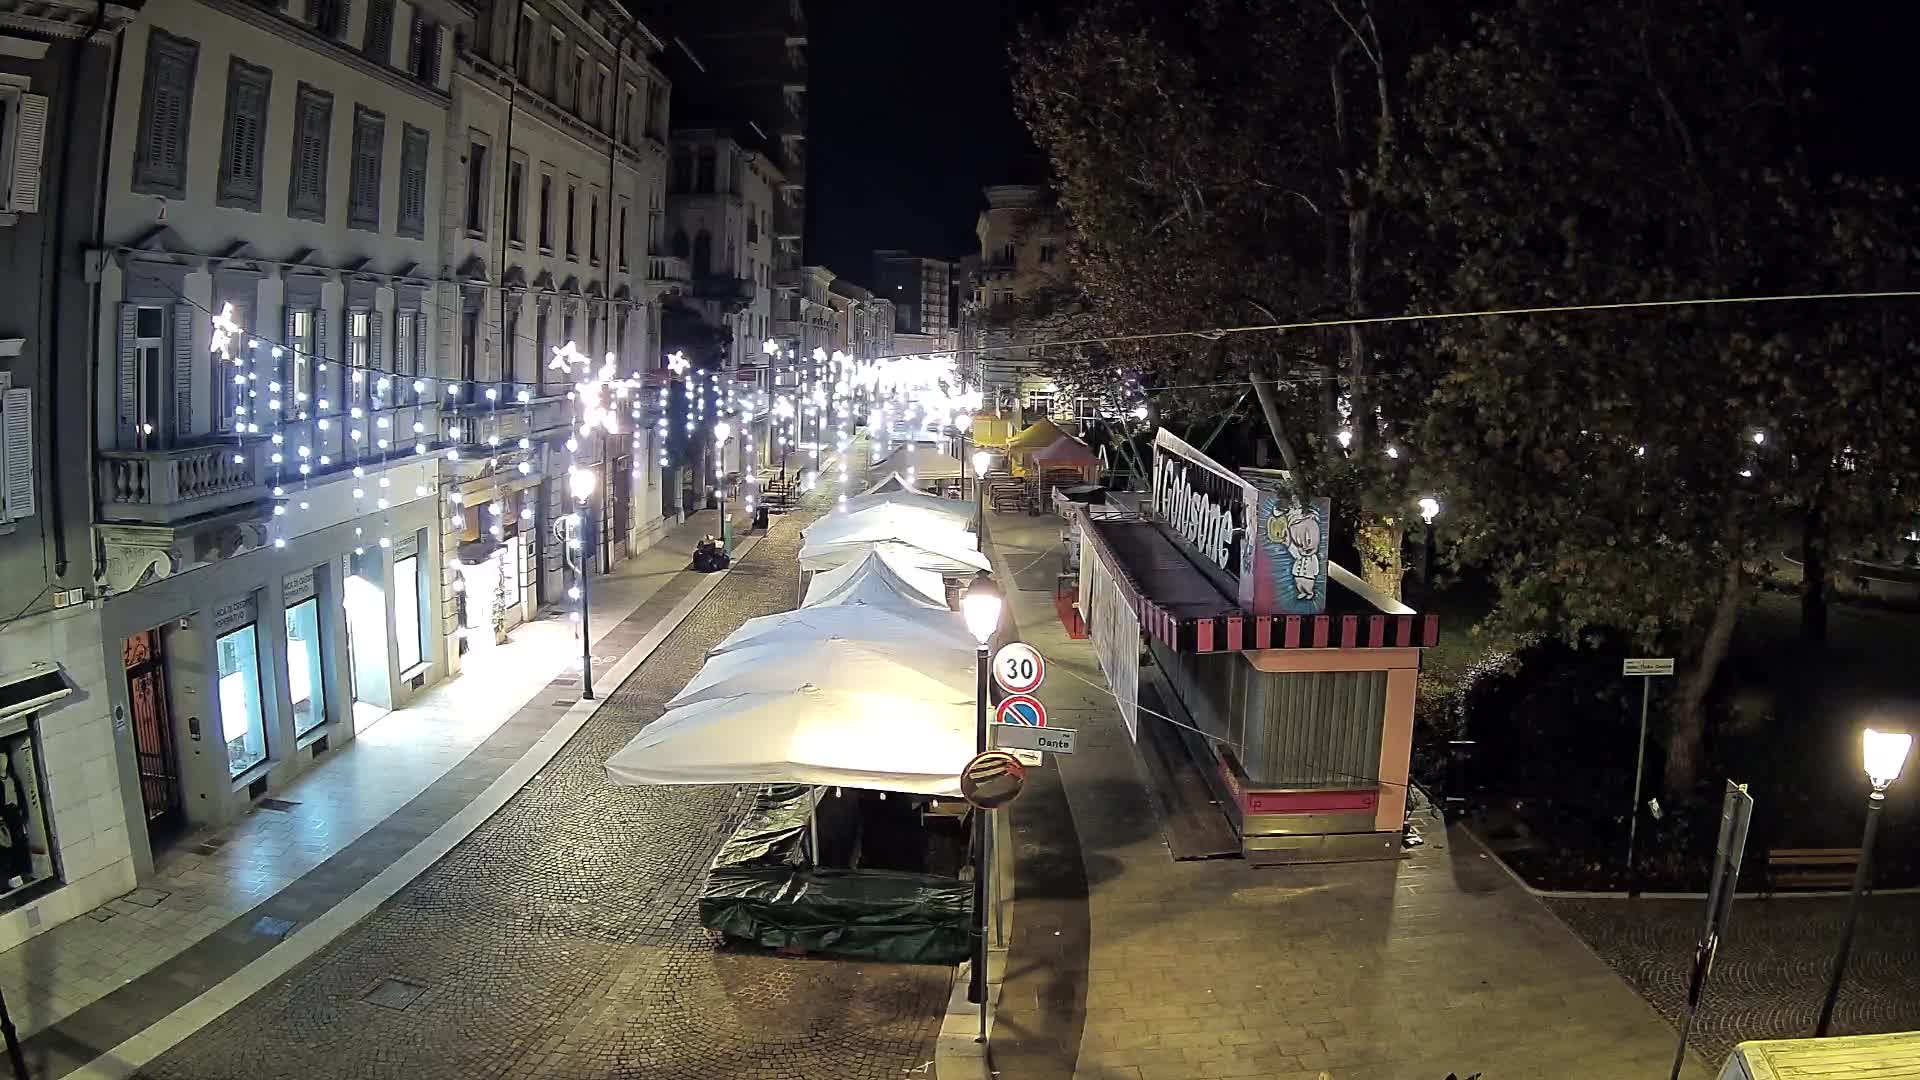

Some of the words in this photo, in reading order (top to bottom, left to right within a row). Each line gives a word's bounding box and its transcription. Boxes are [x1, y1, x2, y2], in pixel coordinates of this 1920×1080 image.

[1163, 458, 1233, 570] Golosone
[1006, 659, 1033, 680] 30
[1038, 737, 1069, 749] Dante
